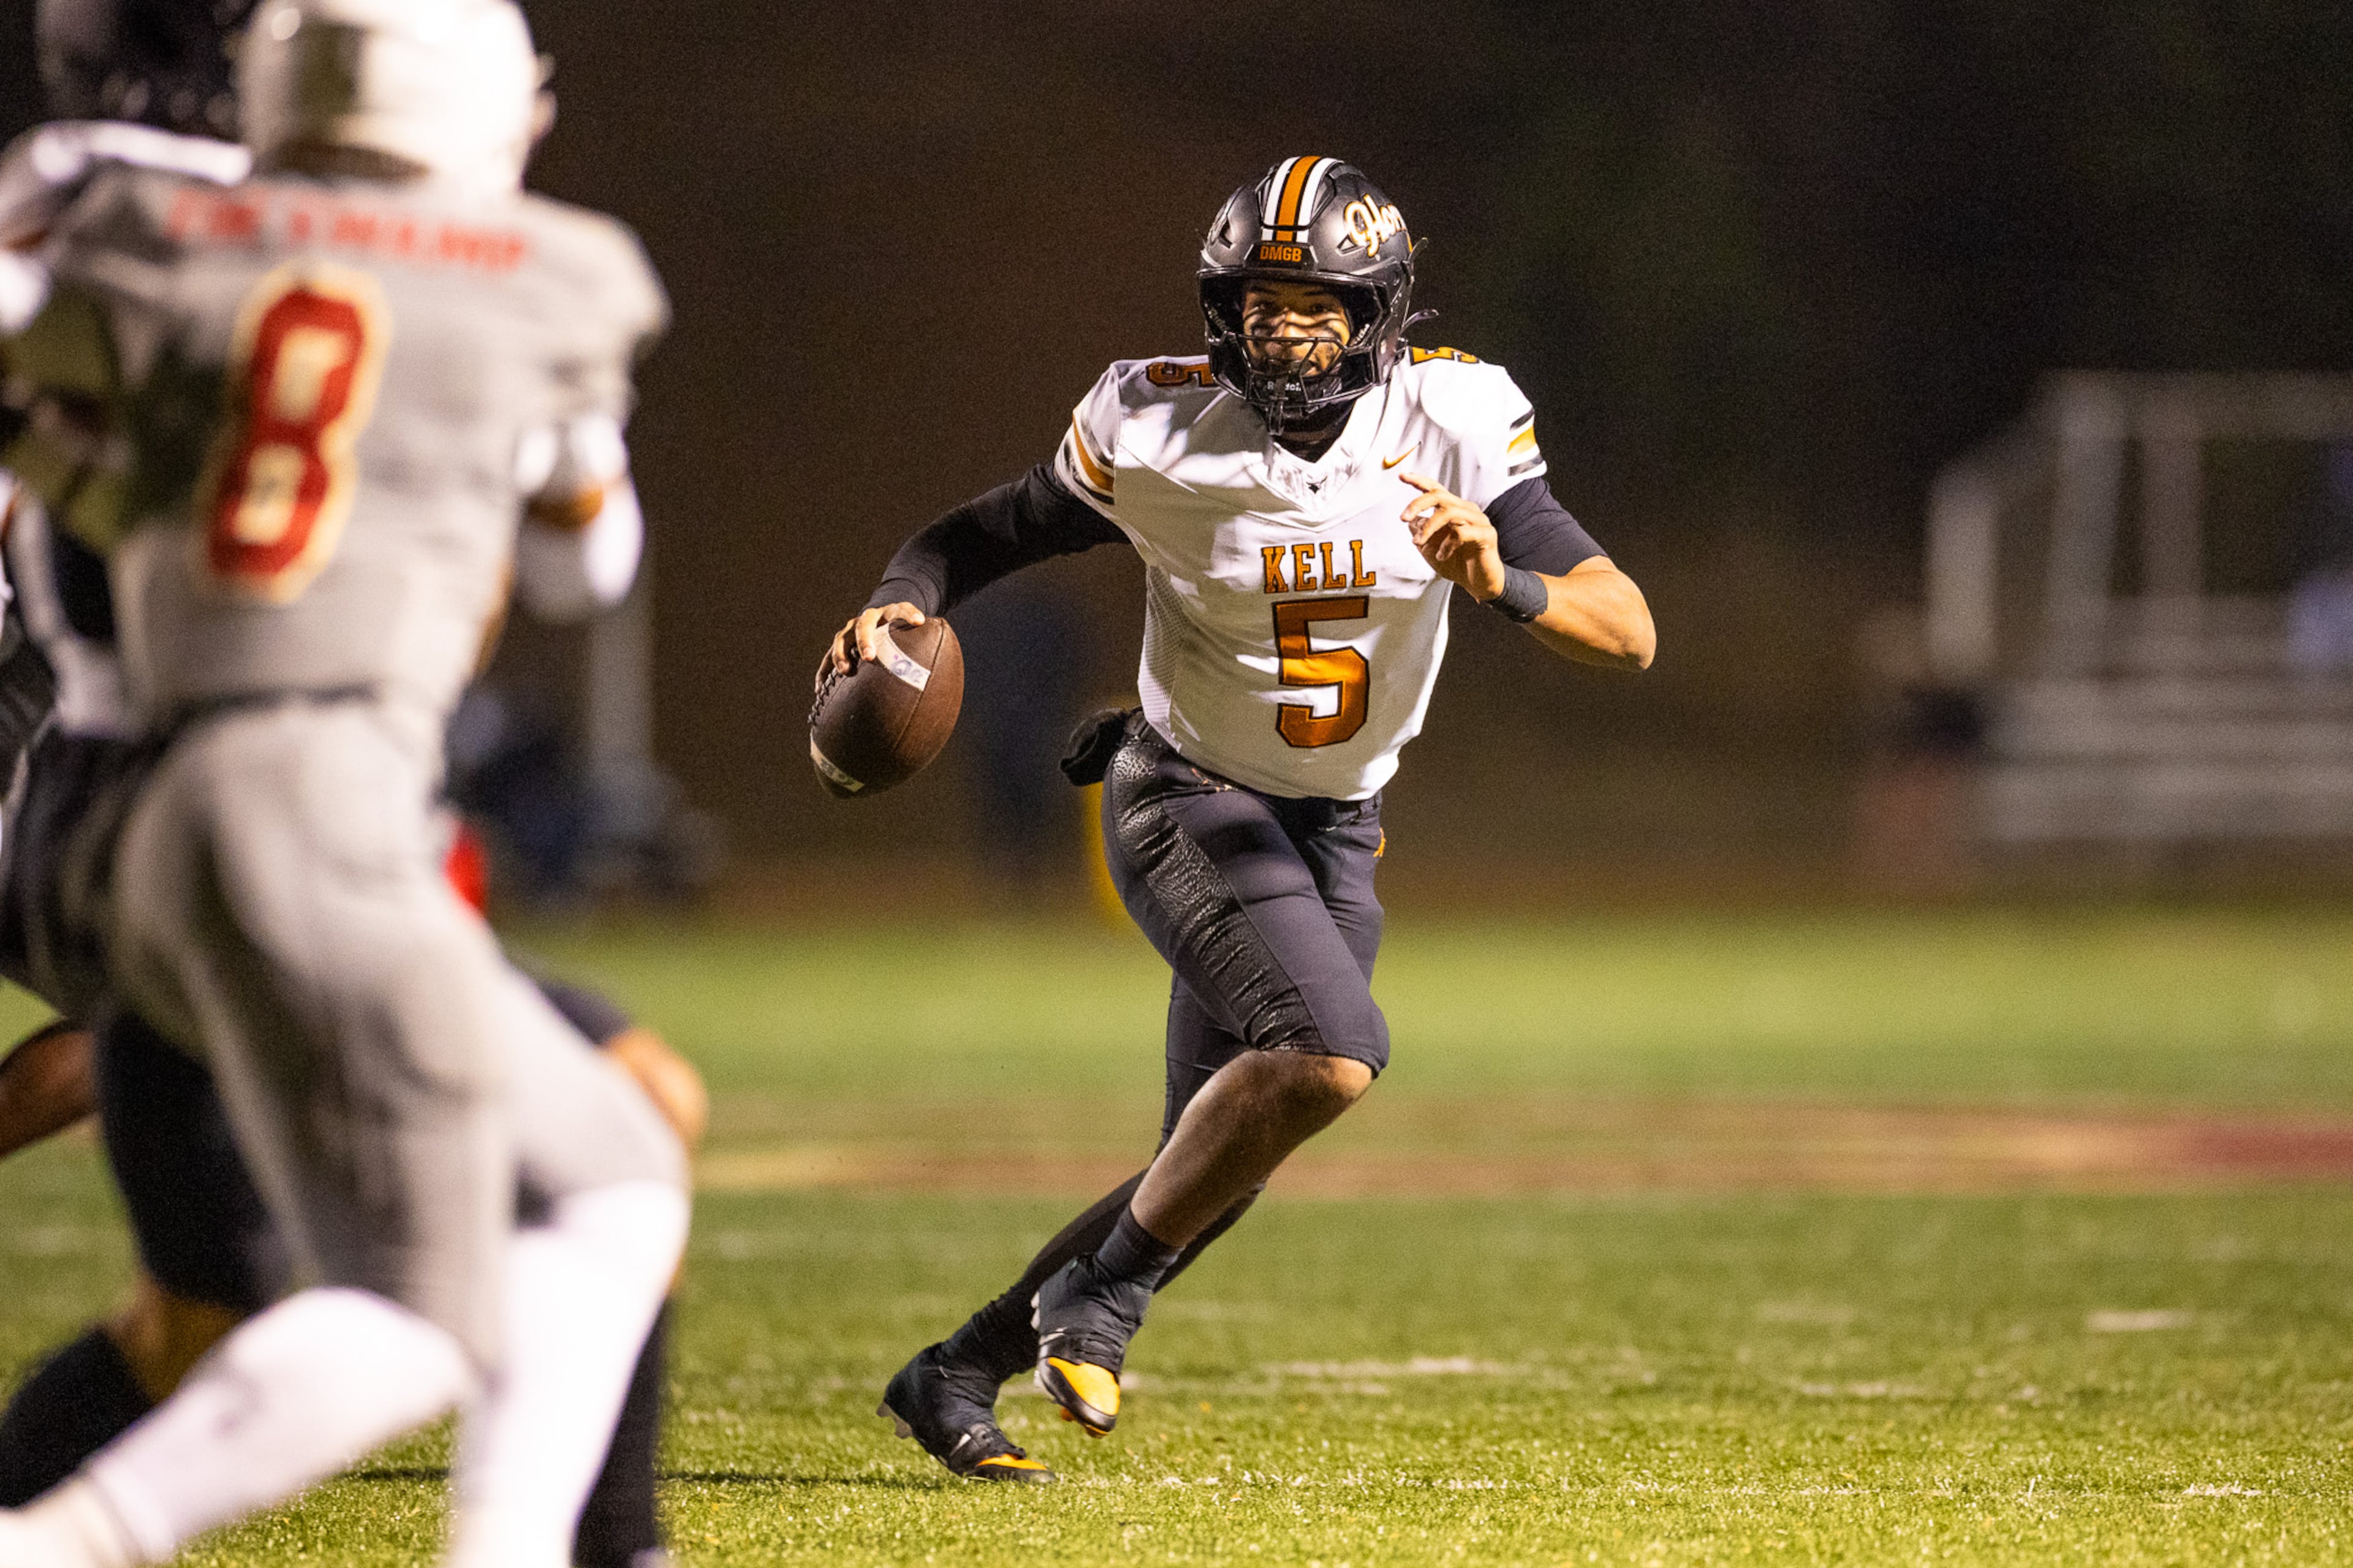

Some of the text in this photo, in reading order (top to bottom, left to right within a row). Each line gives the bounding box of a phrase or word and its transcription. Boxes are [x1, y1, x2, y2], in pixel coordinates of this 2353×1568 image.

[1260, 244, 1302, 262] DMGB
[199, 265, 386, 593] 8
[1262, 540, 1376, 593] KELL
[1271, 596, 1370, 748] 5
